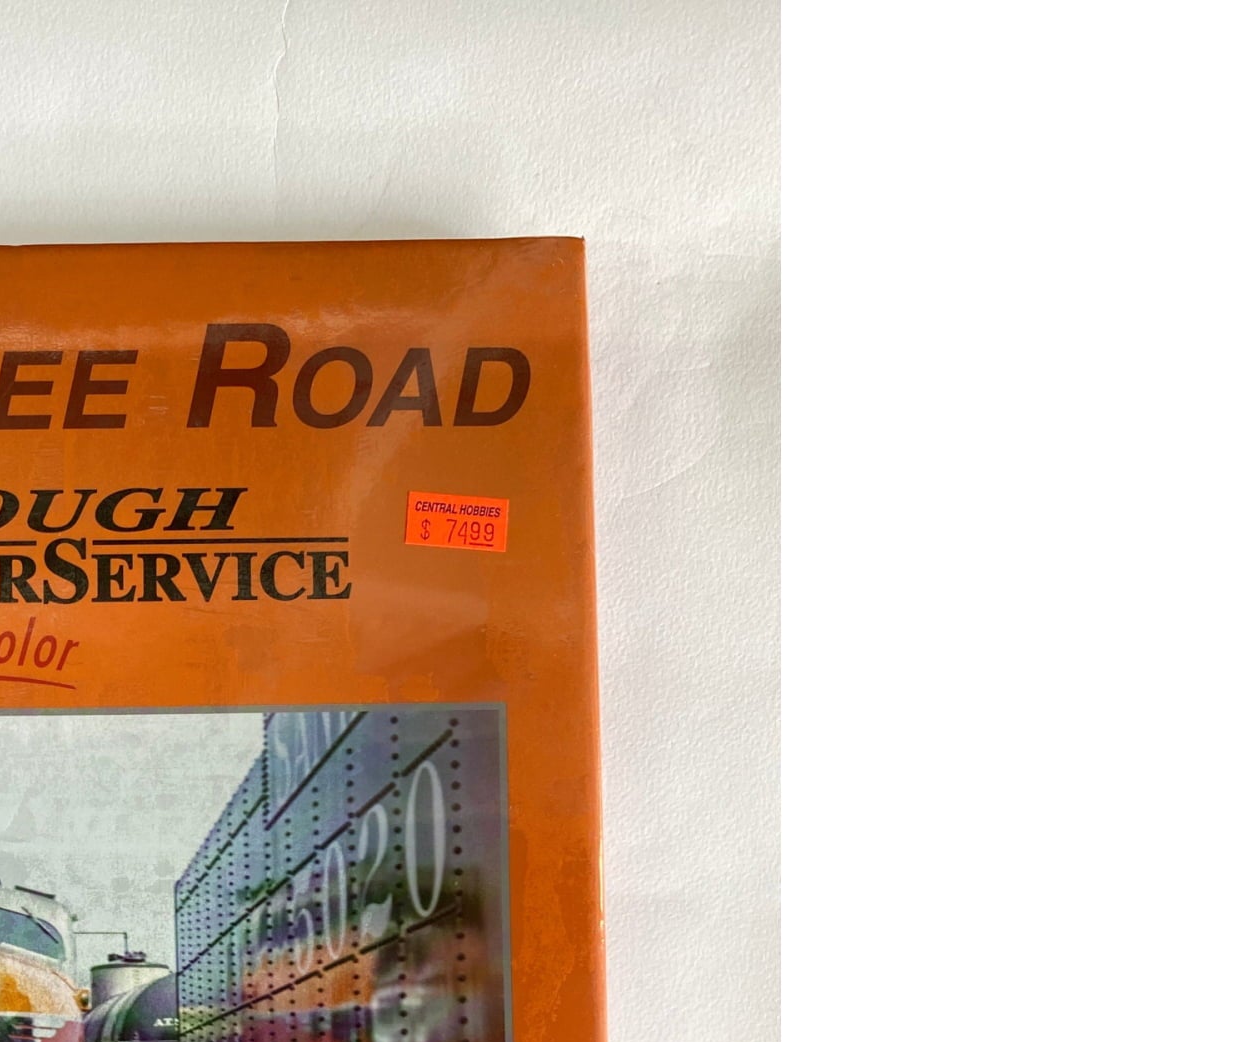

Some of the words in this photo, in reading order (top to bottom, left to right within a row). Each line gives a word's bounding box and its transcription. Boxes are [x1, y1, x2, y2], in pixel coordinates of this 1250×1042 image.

[186, 323, 533, 430] ROAD
[415, 501, 457, 514] CENTRAL
[459, 504, 501, 518] HOBBIES
